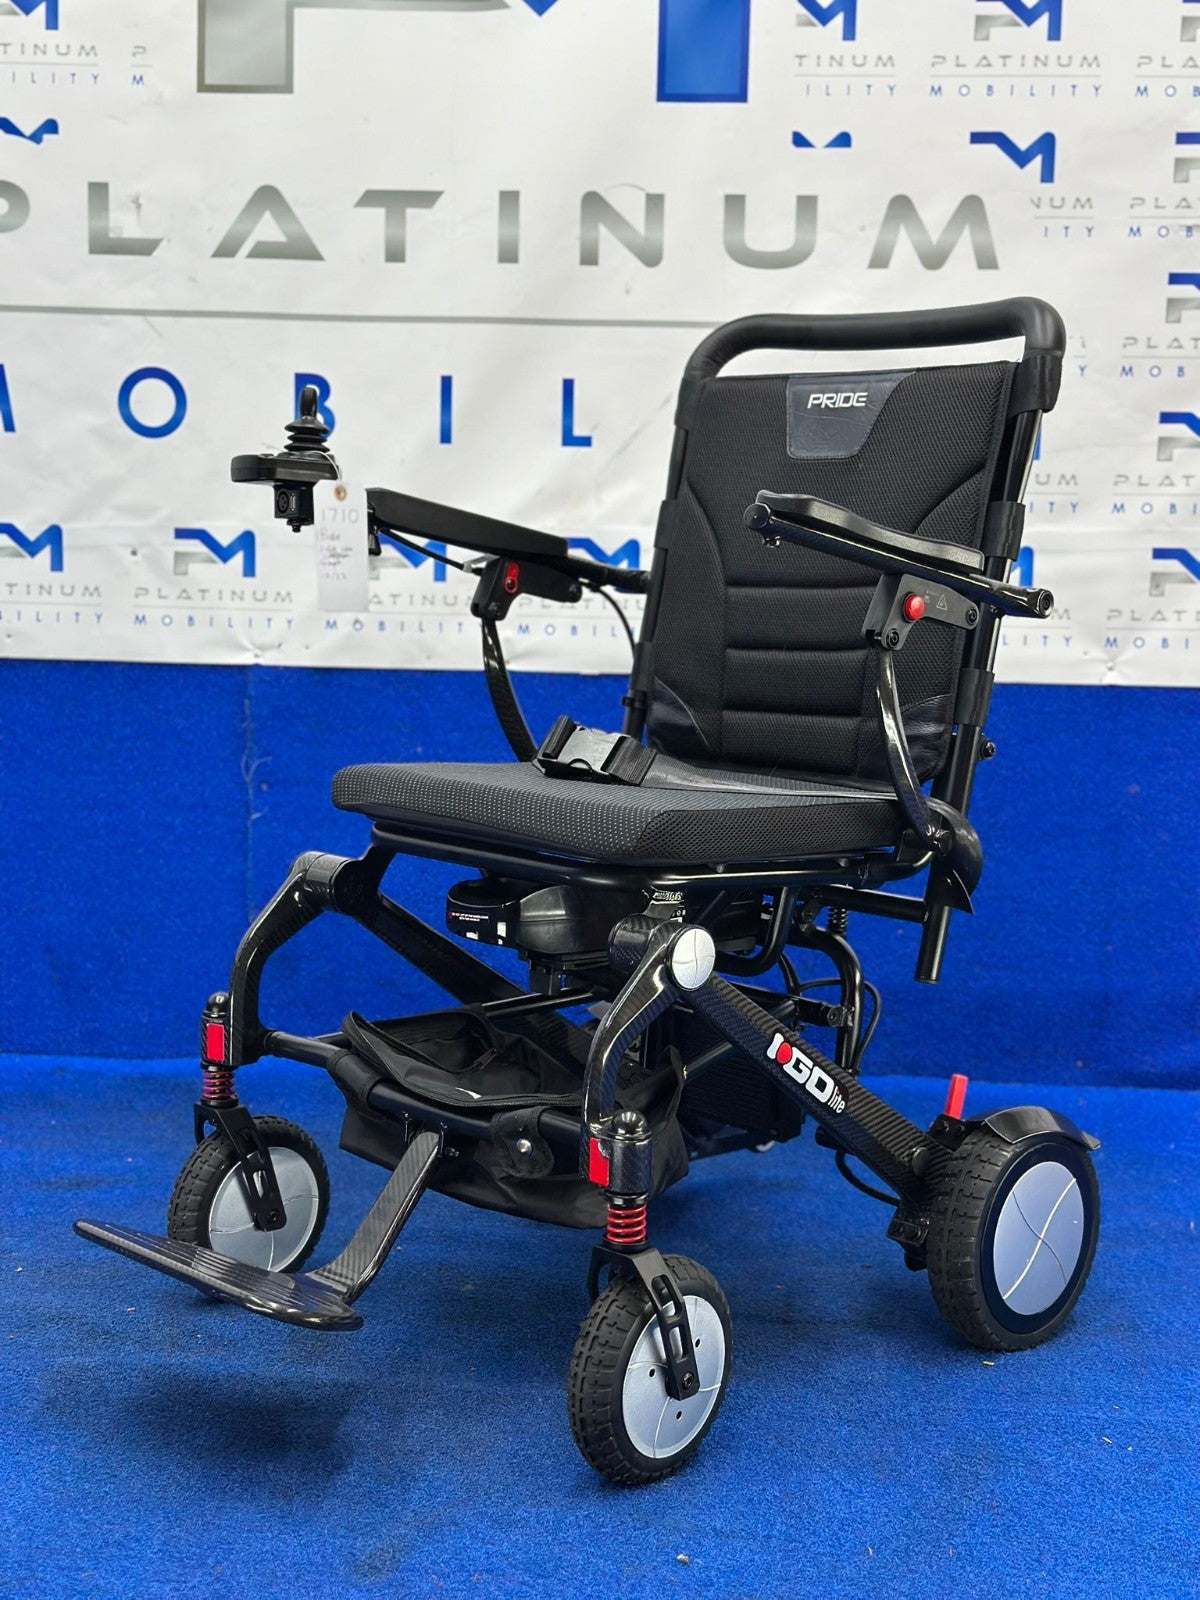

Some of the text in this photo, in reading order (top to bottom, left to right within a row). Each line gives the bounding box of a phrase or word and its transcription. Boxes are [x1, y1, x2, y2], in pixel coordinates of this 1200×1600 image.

[930, 54, 1100, 68] PLATINUM
[929, 84, 1101, 97] MOBILITY
[0, 363, 592, 448] OBIL
[807, 392, 868, 409] PRIDE
[321, 507, 360, 524] 1710
[134, 587, 293, 603] PLATINUM
[133, 614, 294, 630] MOBILITY
